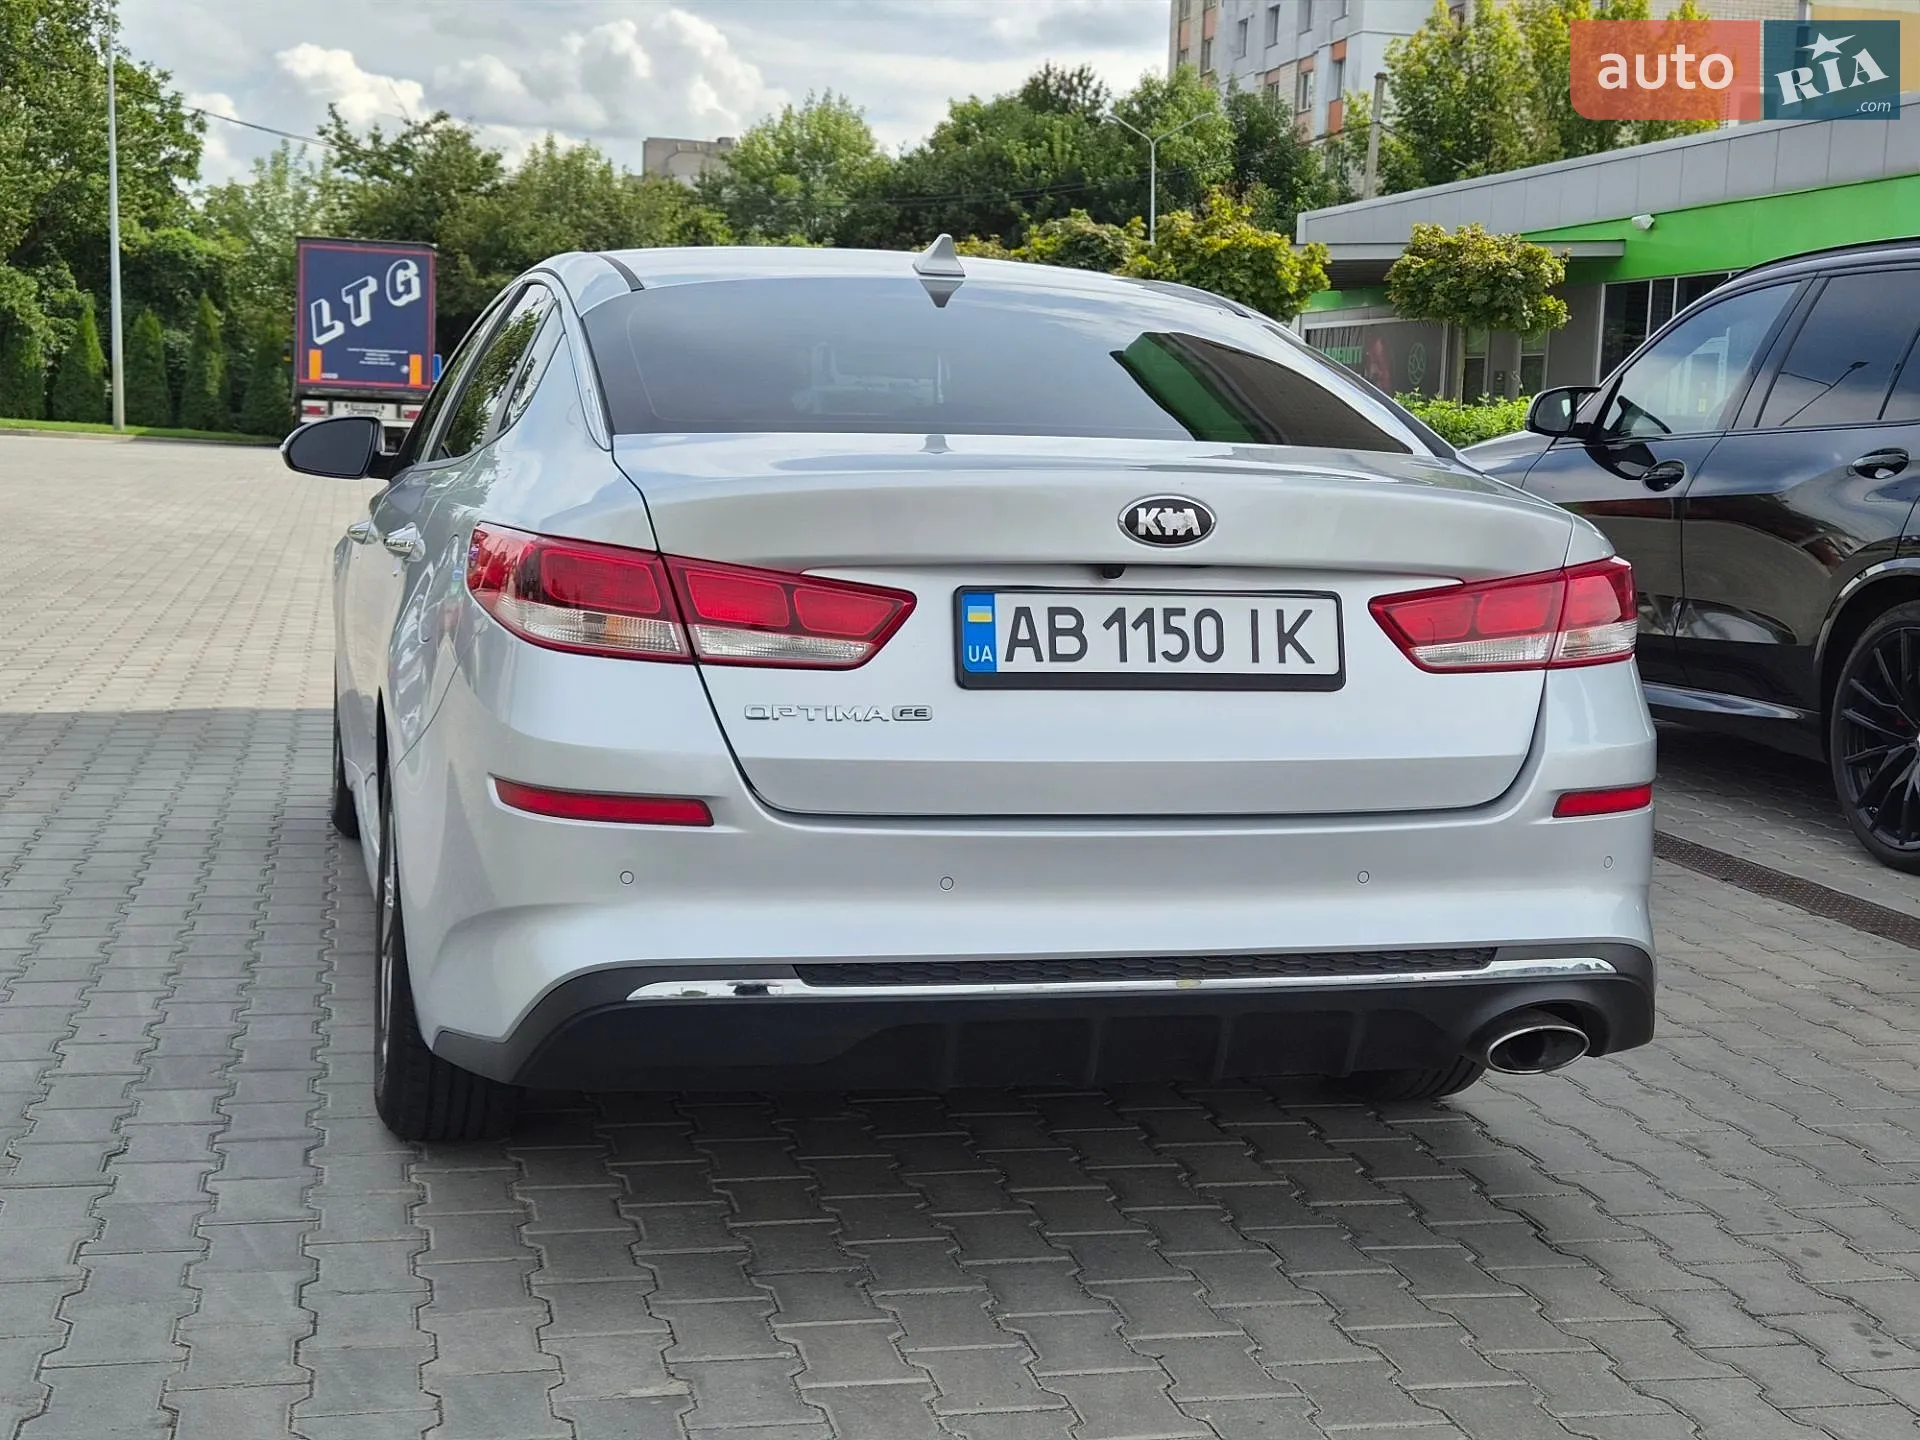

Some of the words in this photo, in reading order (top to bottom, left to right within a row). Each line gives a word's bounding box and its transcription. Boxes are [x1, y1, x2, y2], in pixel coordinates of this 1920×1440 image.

[310, 259, 422, 345] LTG
[967, 645, 994, 663] UA
[1004, 606, 1089, 663] AB
[1102, 606, 1225, 663] 1150
[1249, 608, 1316, 665] IK
[744, 703, 890, 722] OPTIMA
